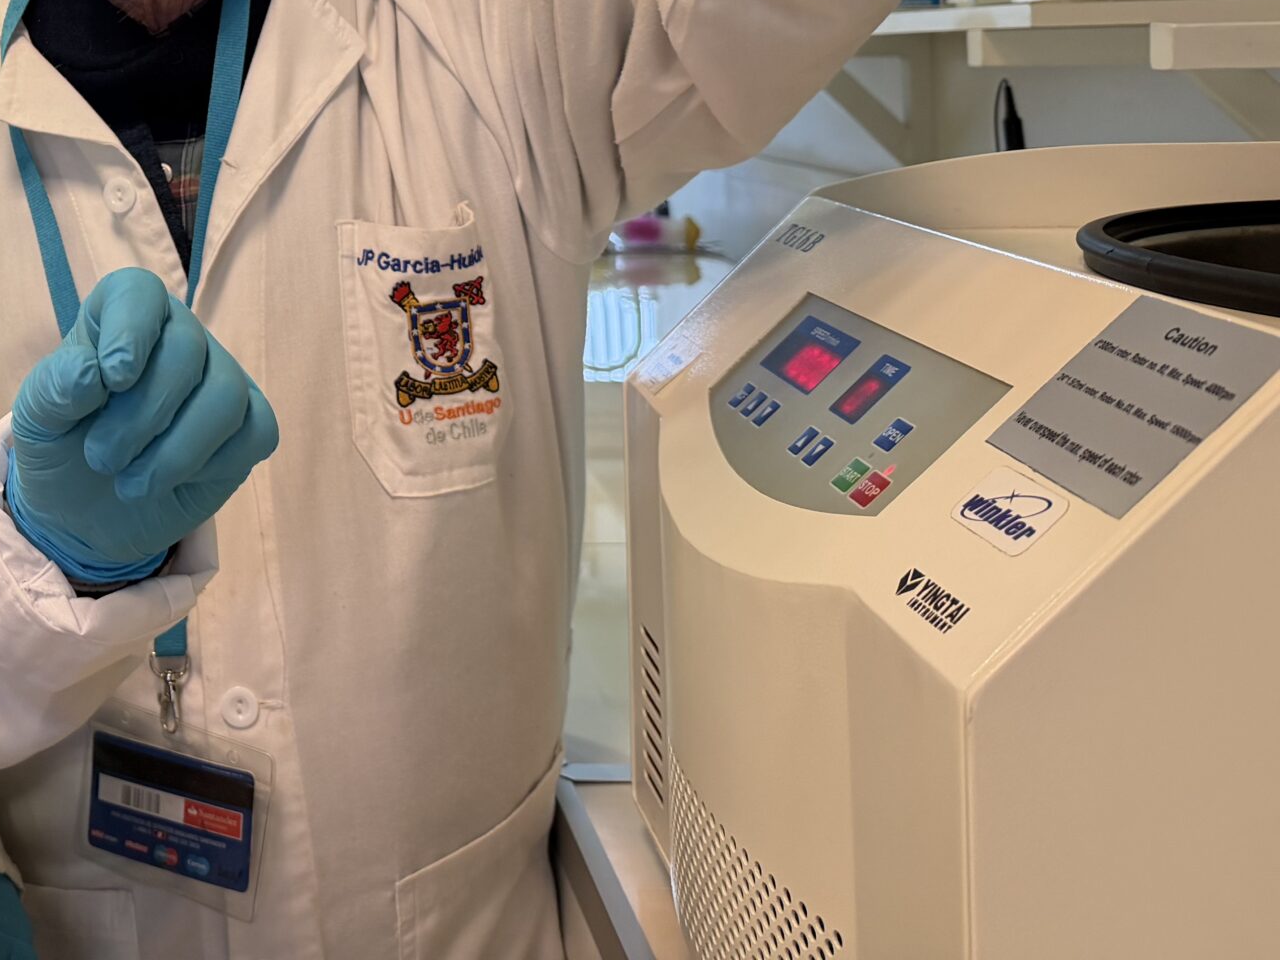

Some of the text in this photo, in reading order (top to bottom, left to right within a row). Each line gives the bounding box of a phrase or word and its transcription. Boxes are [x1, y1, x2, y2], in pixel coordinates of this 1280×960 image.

[775, 223, 825, 253] TG16B
[357, 248, 375, 266] JP
[1164, 327, 1218, 356] Caution
[426, 419, 487, 445] de Chile
[882, 426, 905, 444] OPEN
[1028, 421, 1063, 443] overspeed
[1055, 433, 1070, 448] the
[1078, 448, 1106, 466] speed
[1097, 457, 1113, 469] of
[839, 466, 861, 484] START
[1104, 462, 1127, 478] each
[858, 480, 880, 497] STOP
[962, 493, 1036, 541] winkler
[916, 578, 971, 625] YINGTAI
[906, 597, 954, 635] INSTRUMENT
